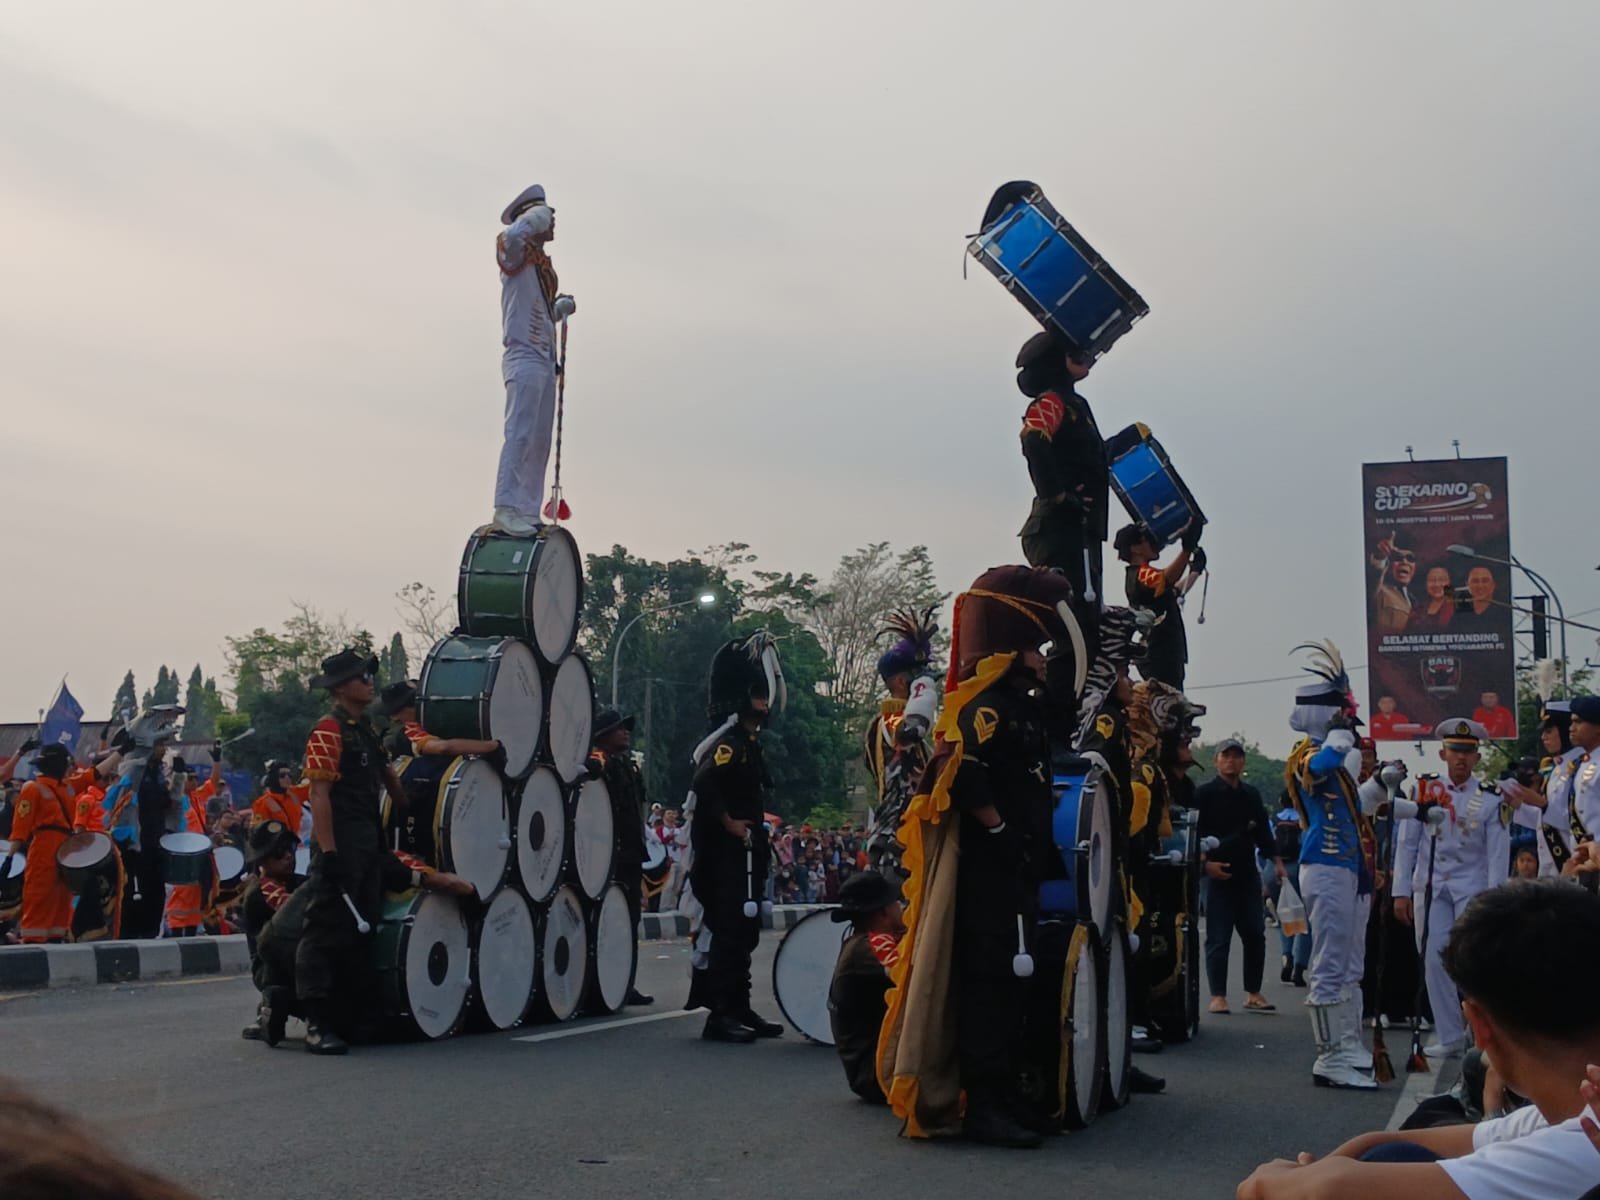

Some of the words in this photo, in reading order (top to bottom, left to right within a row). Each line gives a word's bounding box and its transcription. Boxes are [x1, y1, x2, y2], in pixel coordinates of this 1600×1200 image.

[1374, 498, 1411, 511] CUP
[1383, 635, 1430, 645] SELAMAT
[1432, 633, 1499, 643] BERTANDING
